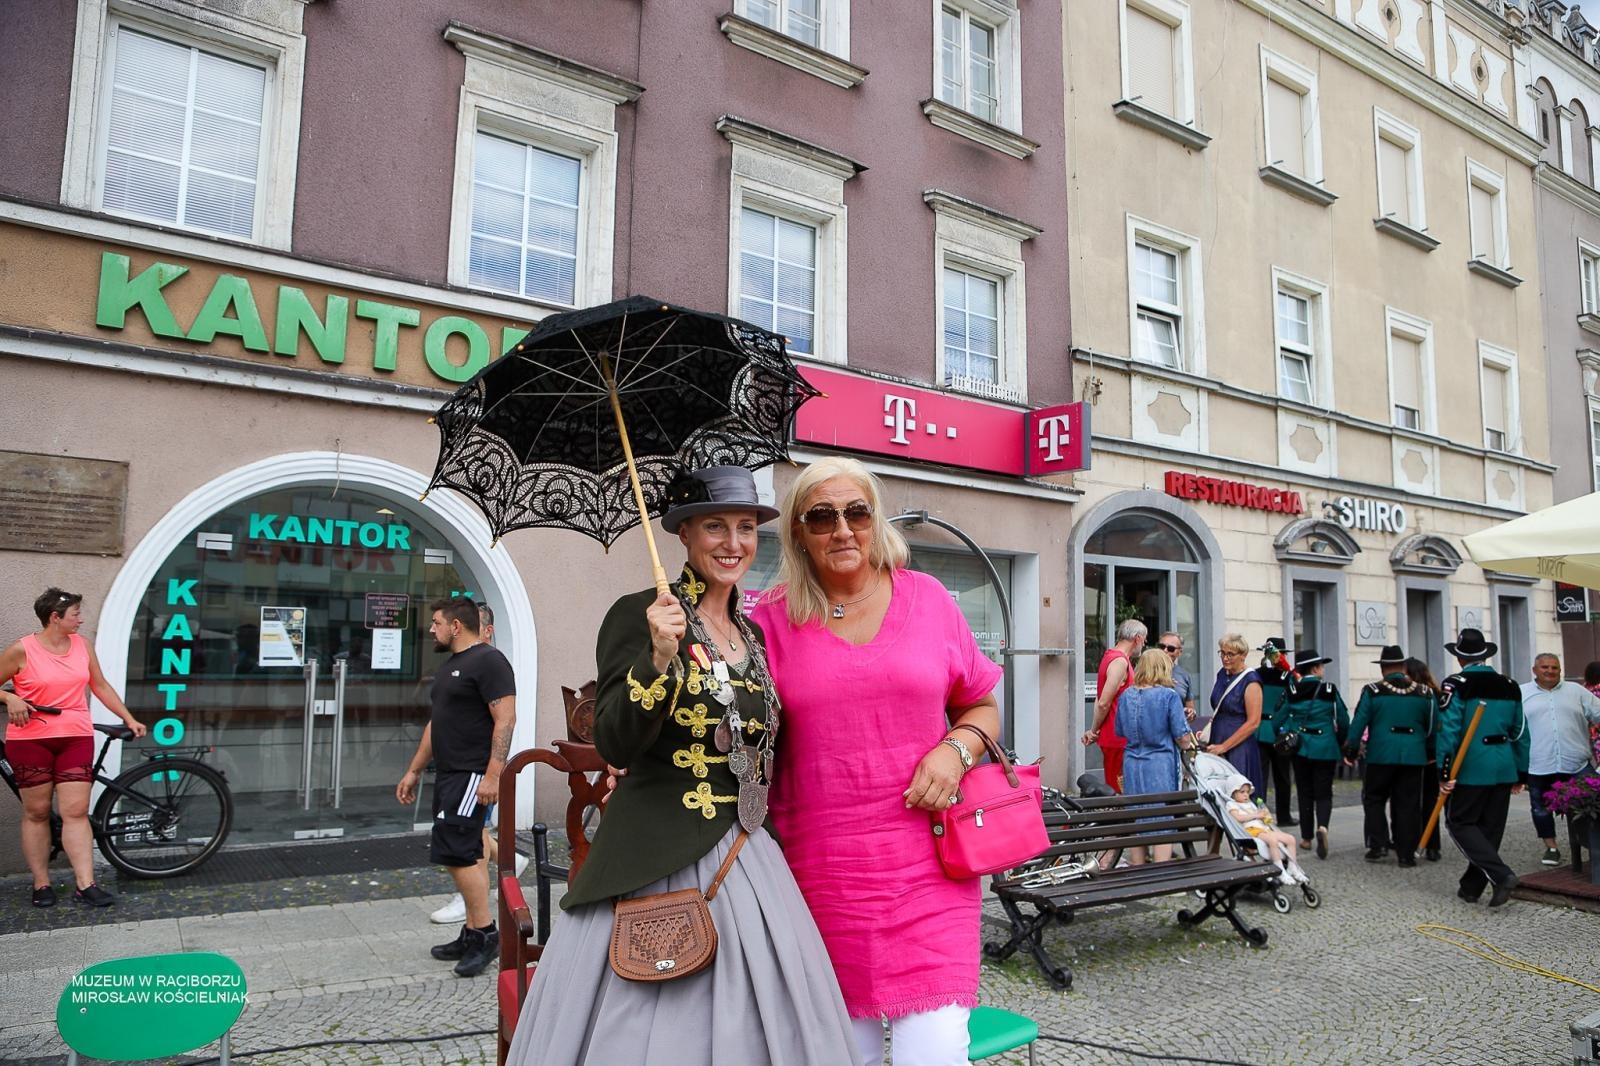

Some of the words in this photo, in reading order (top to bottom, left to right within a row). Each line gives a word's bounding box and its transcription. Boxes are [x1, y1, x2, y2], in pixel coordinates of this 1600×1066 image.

[1038, 414, 1070, 462] T
[1164, 470, 1304, 515] RESTAURACJA
[249, 512, 412, 550] KANTOR
[1340, 496, 1407, 534] SHIRO
